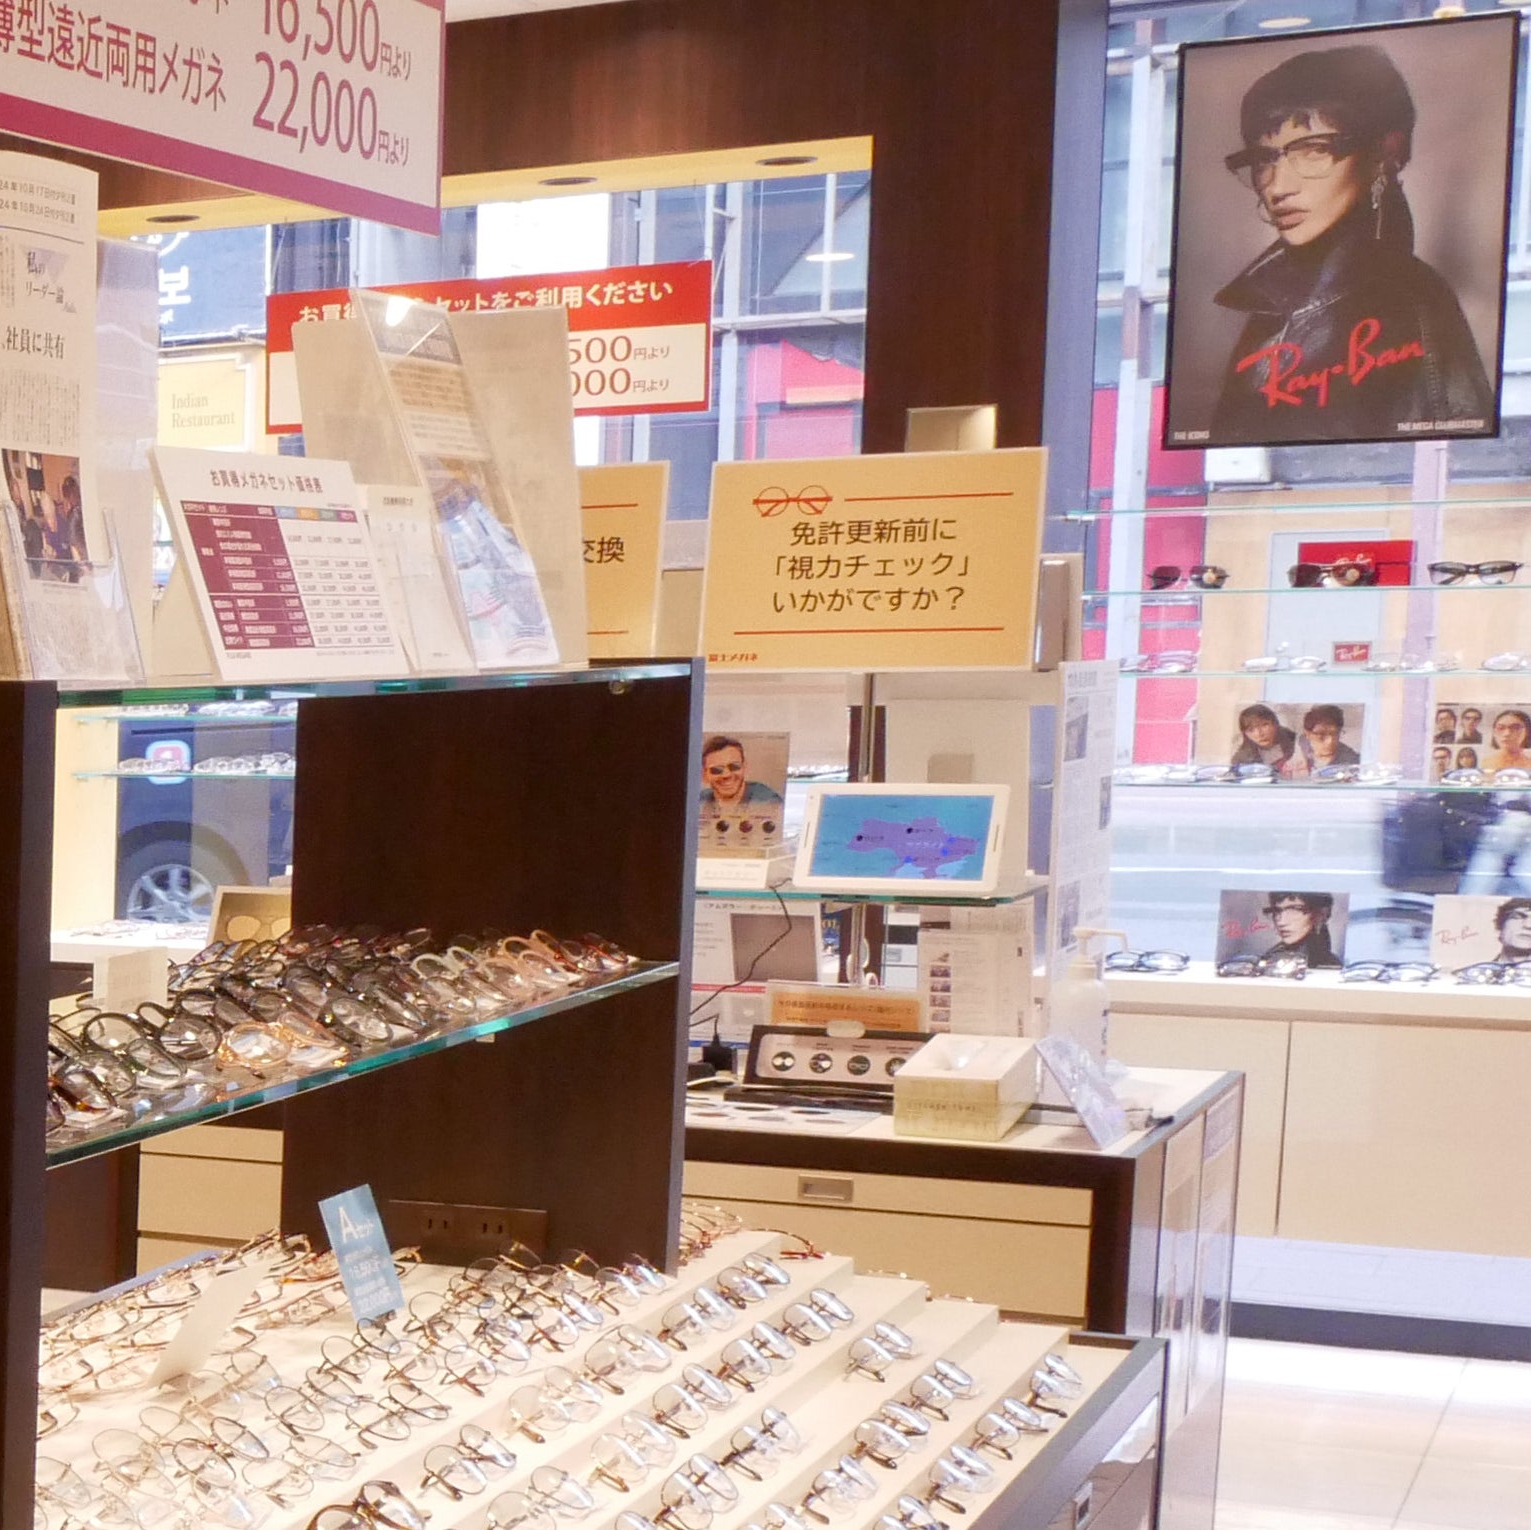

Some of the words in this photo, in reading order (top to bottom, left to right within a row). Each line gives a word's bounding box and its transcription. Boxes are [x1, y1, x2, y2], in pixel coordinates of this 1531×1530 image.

[252, 51, 410, 168] 22,000円より
[1235, 317, 1426, 409] Ray-Ban
[172, 392, 209, 410] Indian
[171, 411, 235, 429] Restaurant
[790, 518, 957, 546] 免許更新前に
[775, 552, 969, 580] 「視力チェック」
[773, 585, 965, 613] いかがですか？
